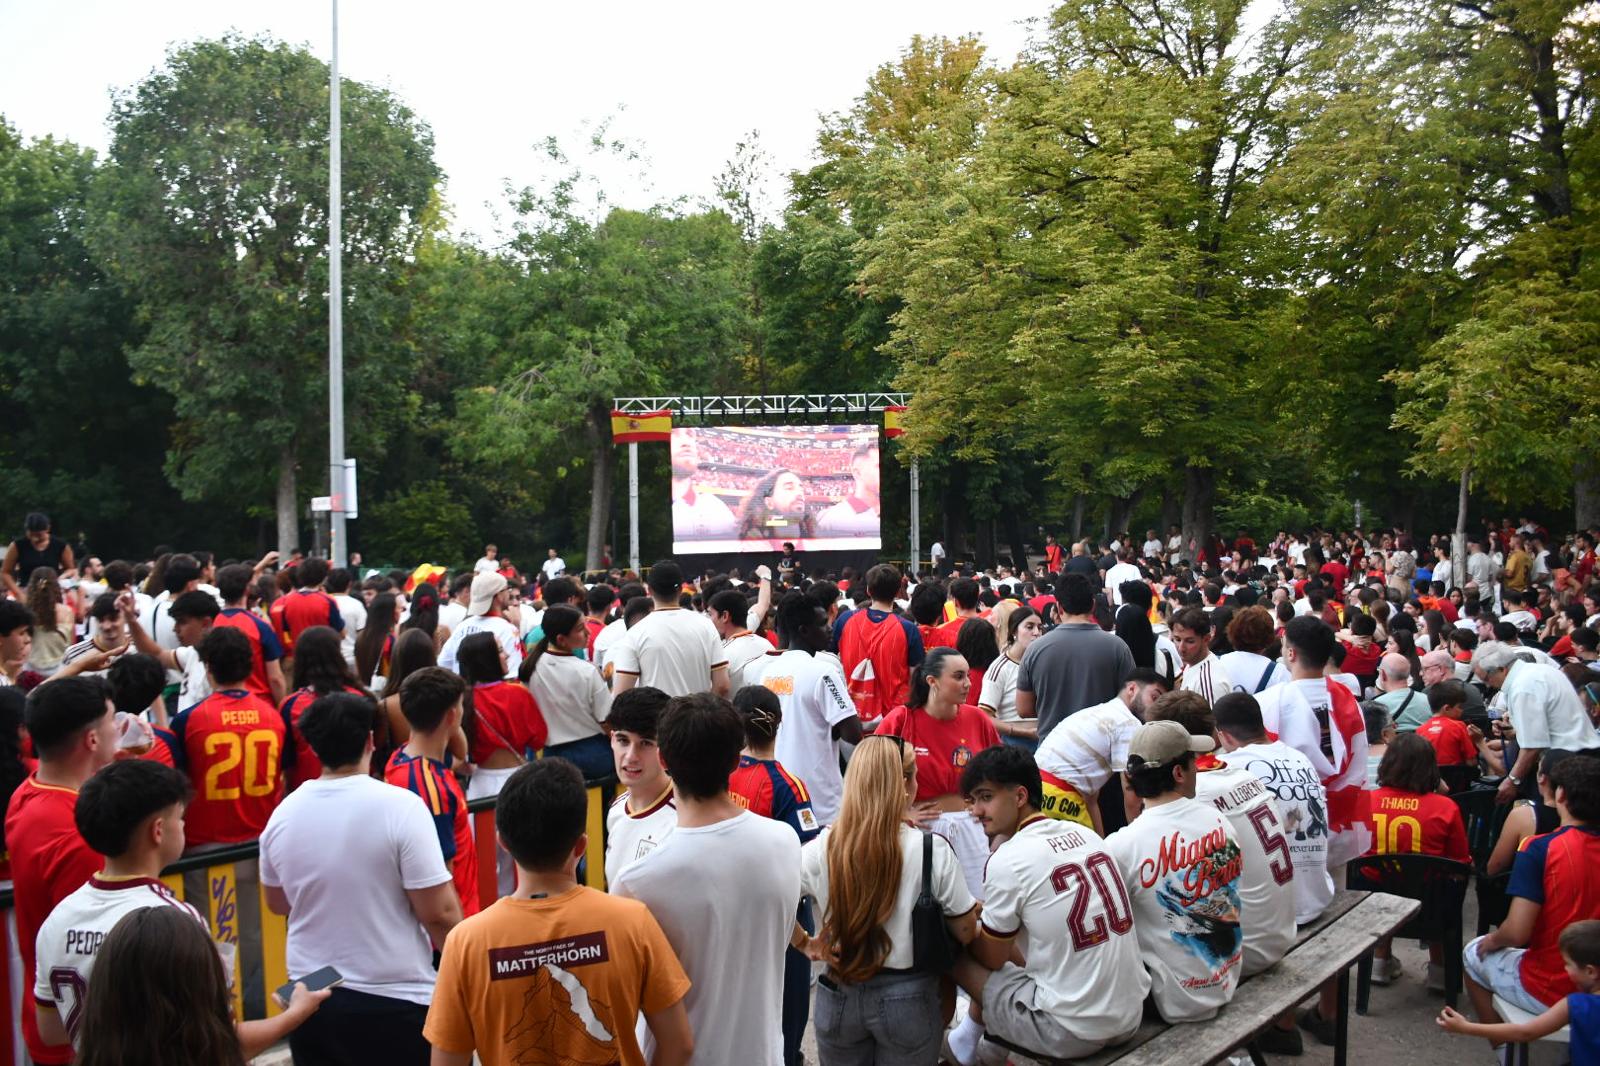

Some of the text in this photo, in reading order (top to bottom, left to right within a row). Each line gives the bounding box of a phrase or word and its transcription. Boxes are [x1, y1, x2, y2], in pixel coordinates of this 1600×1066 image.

[823, 675, 848, 710] NETSHOES
[221, 710, 259, 726] PEDRI
[204, 729, 279, 801] 20
[1381, 797, 1419, 811] THIAGO
[1046, 830, 1087, 854] PEDRI
[1246, 803, 1294, 887] 5
[1372, 813, 1421, 856] 10
[1140, 818, 1227, 889] Miami
[1050, 851, 1133, 953] 20
[65, 930, 107, 955] PEDR
[497, 945, 602, 974] MATTERHORN
